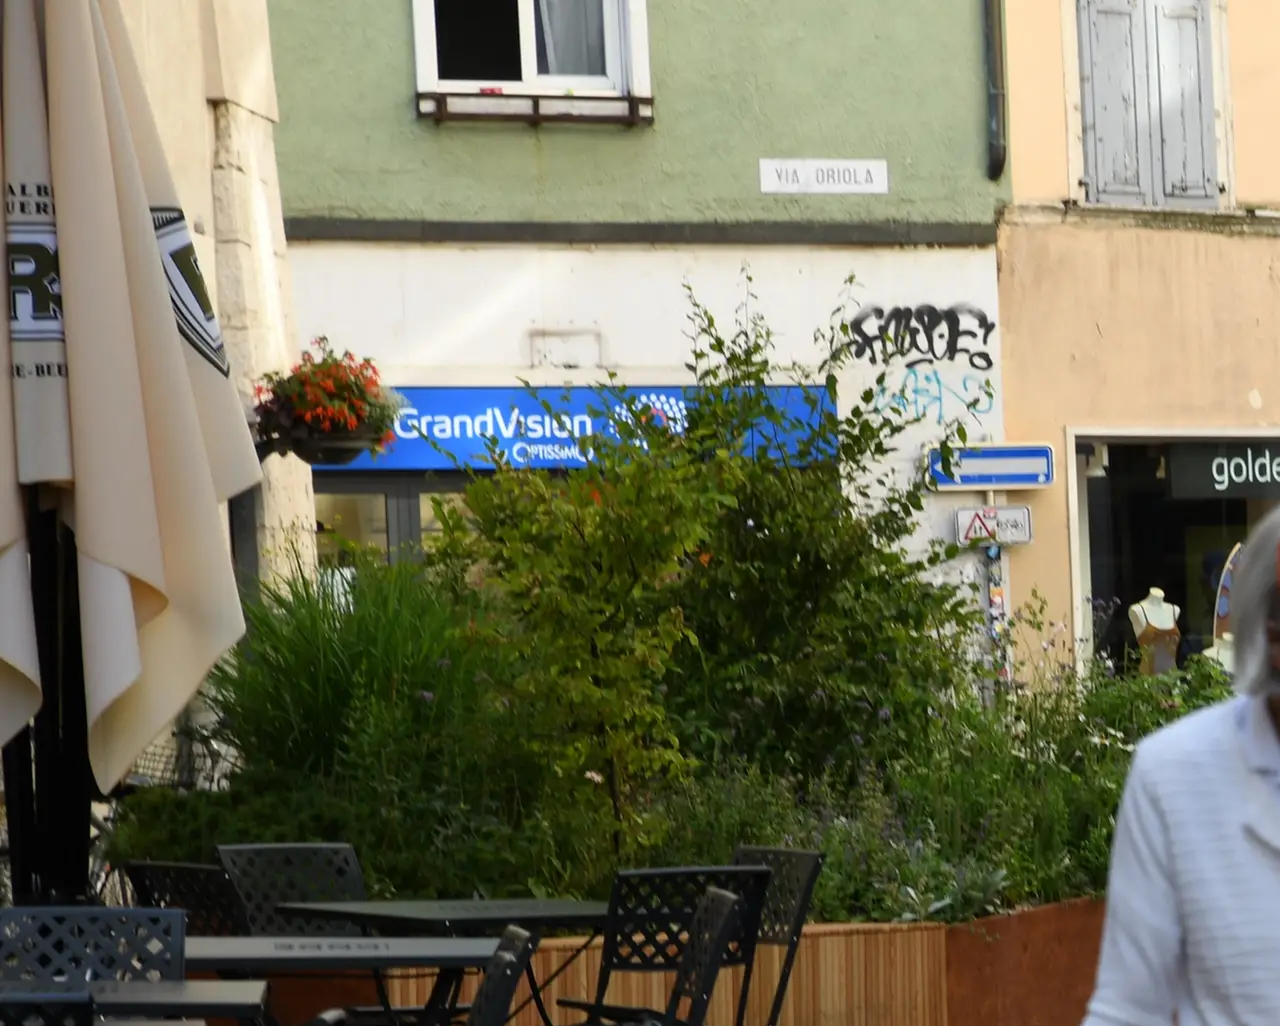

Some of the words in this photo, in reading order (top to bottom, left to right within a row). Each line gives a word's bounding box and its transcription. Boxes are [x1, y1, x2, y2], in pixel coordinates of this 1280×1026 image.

[774, 167, 800, 184] VIA
[815, 167, 874, 185] ORIOLA
[393, 407, 593, 439] GrandVision
